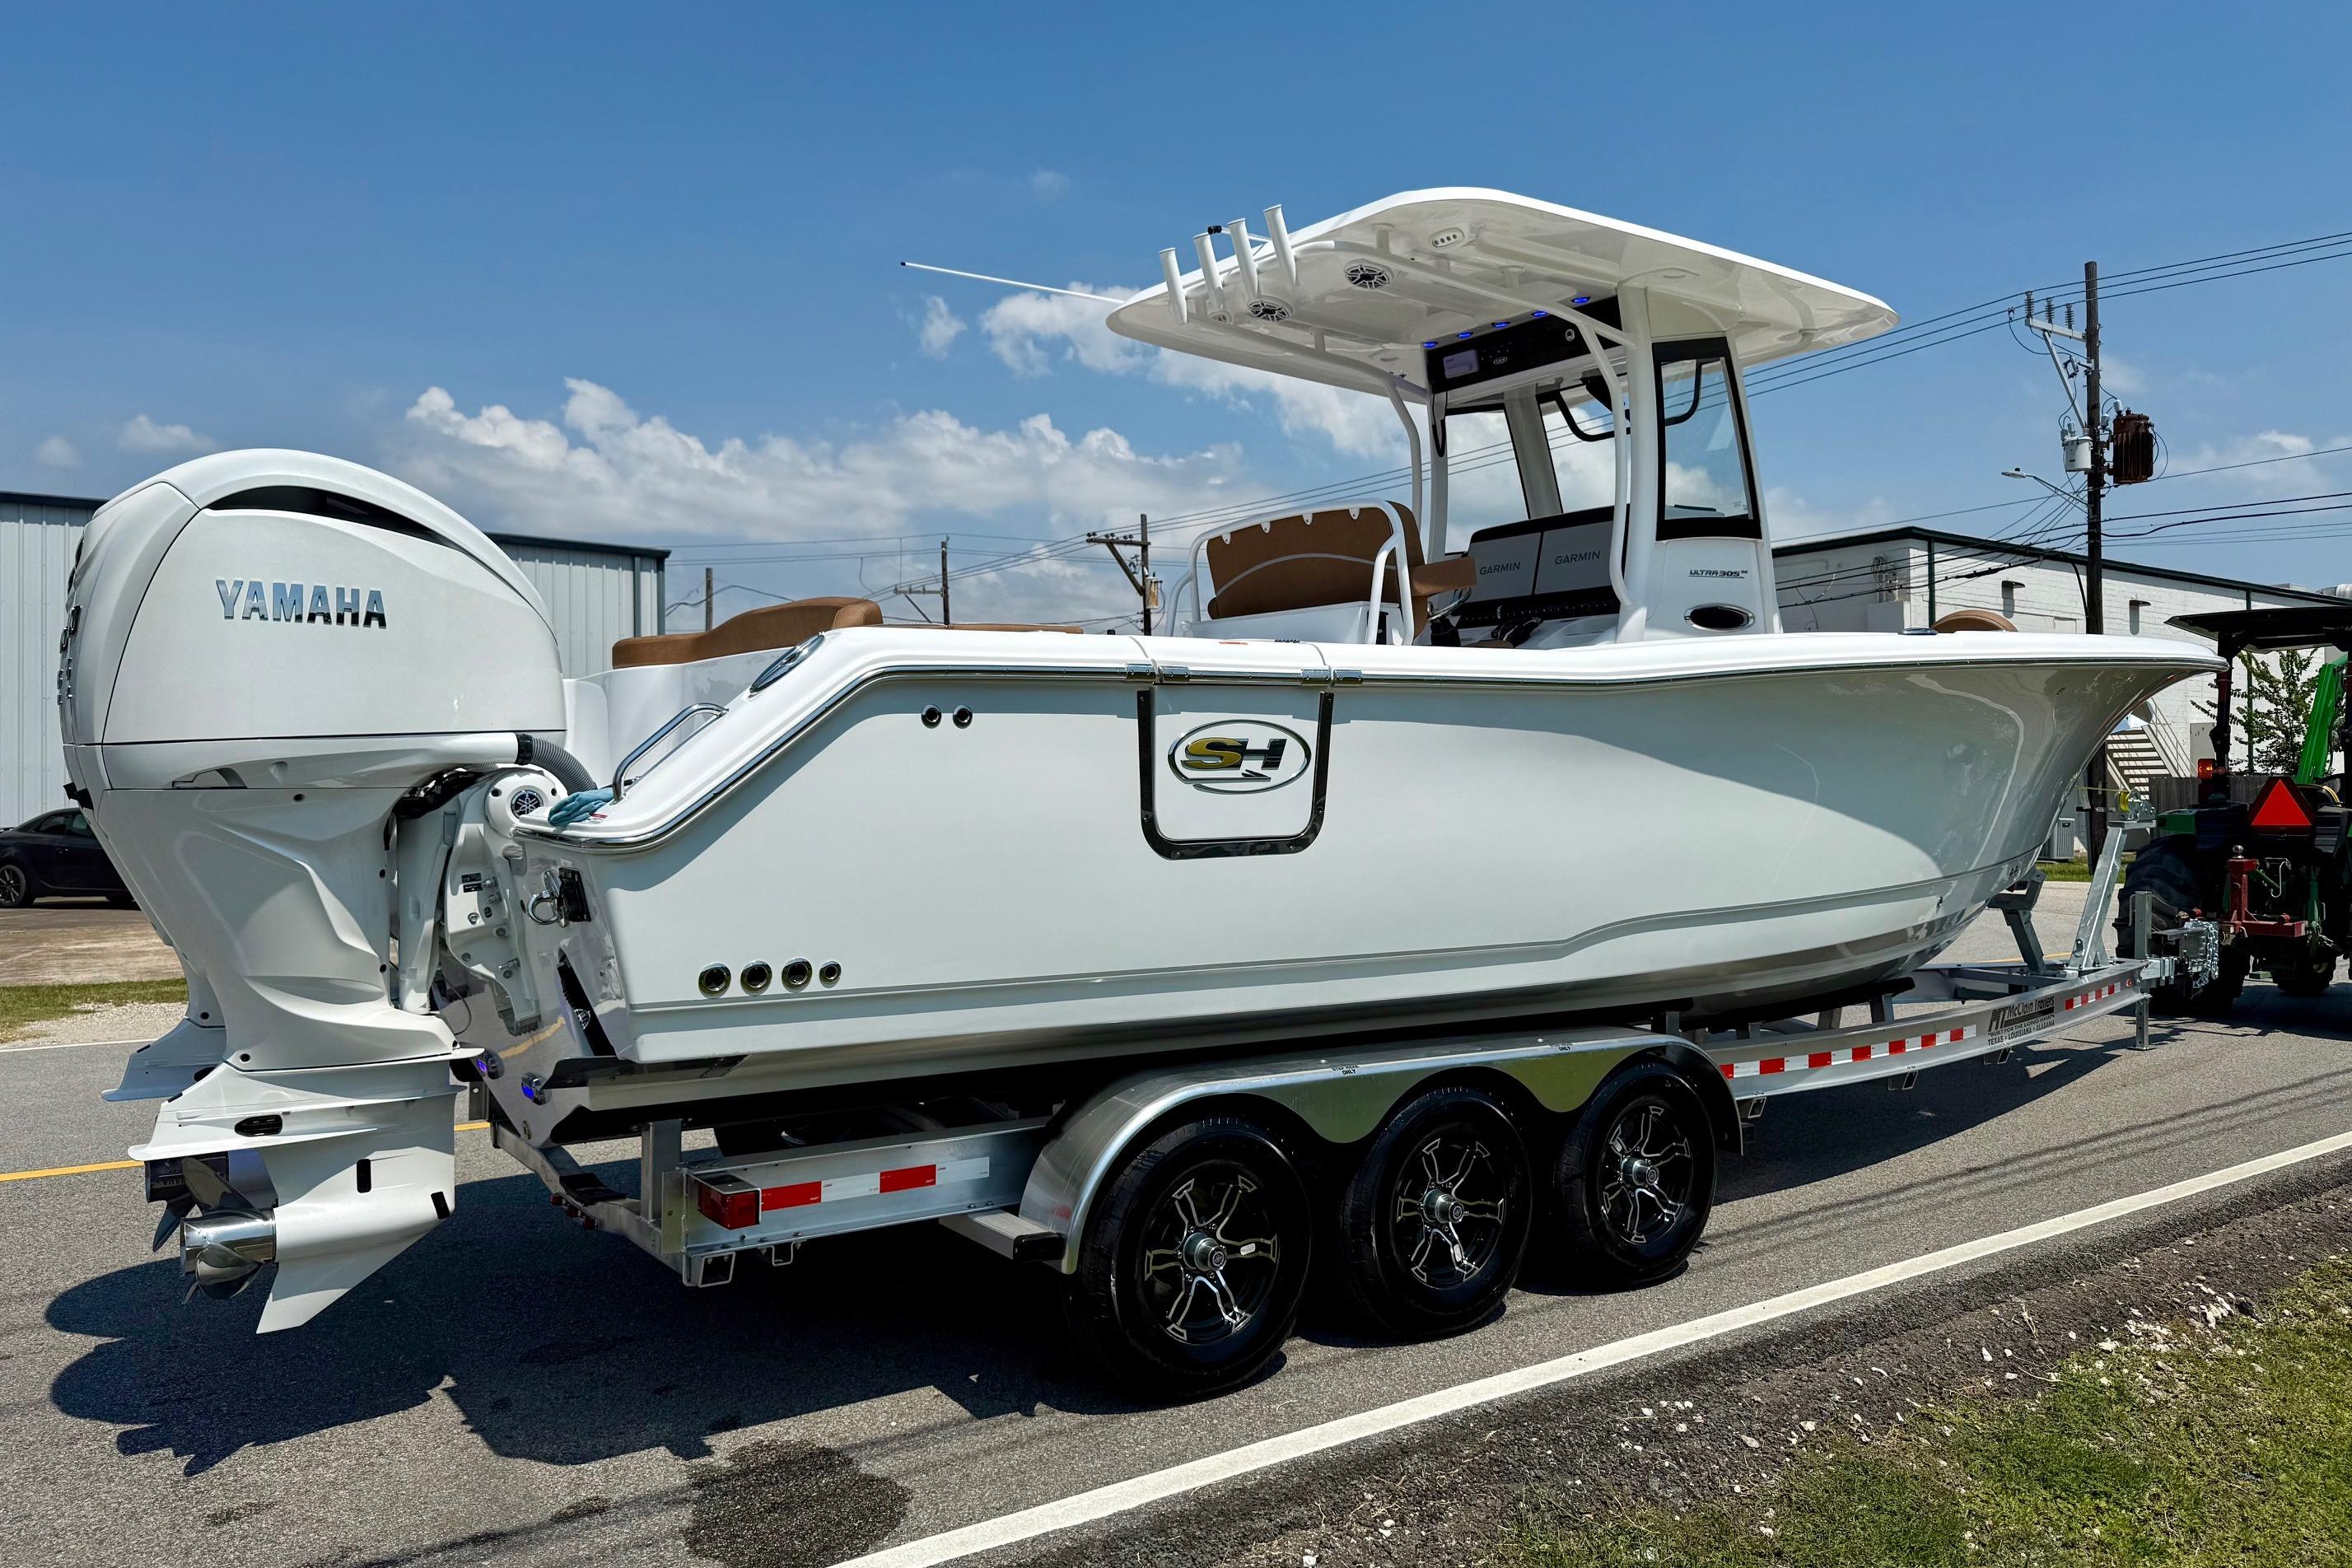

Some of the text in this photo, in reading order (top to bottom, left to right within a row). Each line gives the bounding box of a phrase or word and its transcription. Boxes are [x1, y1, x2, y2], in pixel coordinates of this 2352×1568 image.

[1479, 562, 1521, 576] GARMIN
[1554, 550, 1601, 565] GARMIN
[216, 579, 387, 630] YAMAHA
[1180, 736, 1288, 771] SH
[2008, 1001, 2034, 1020] McClain
[2034, 996, 2055, 1011] Trailers
[1988, 1020, 2055, 1047] TEXAS LOUISIANA ALABAMA
